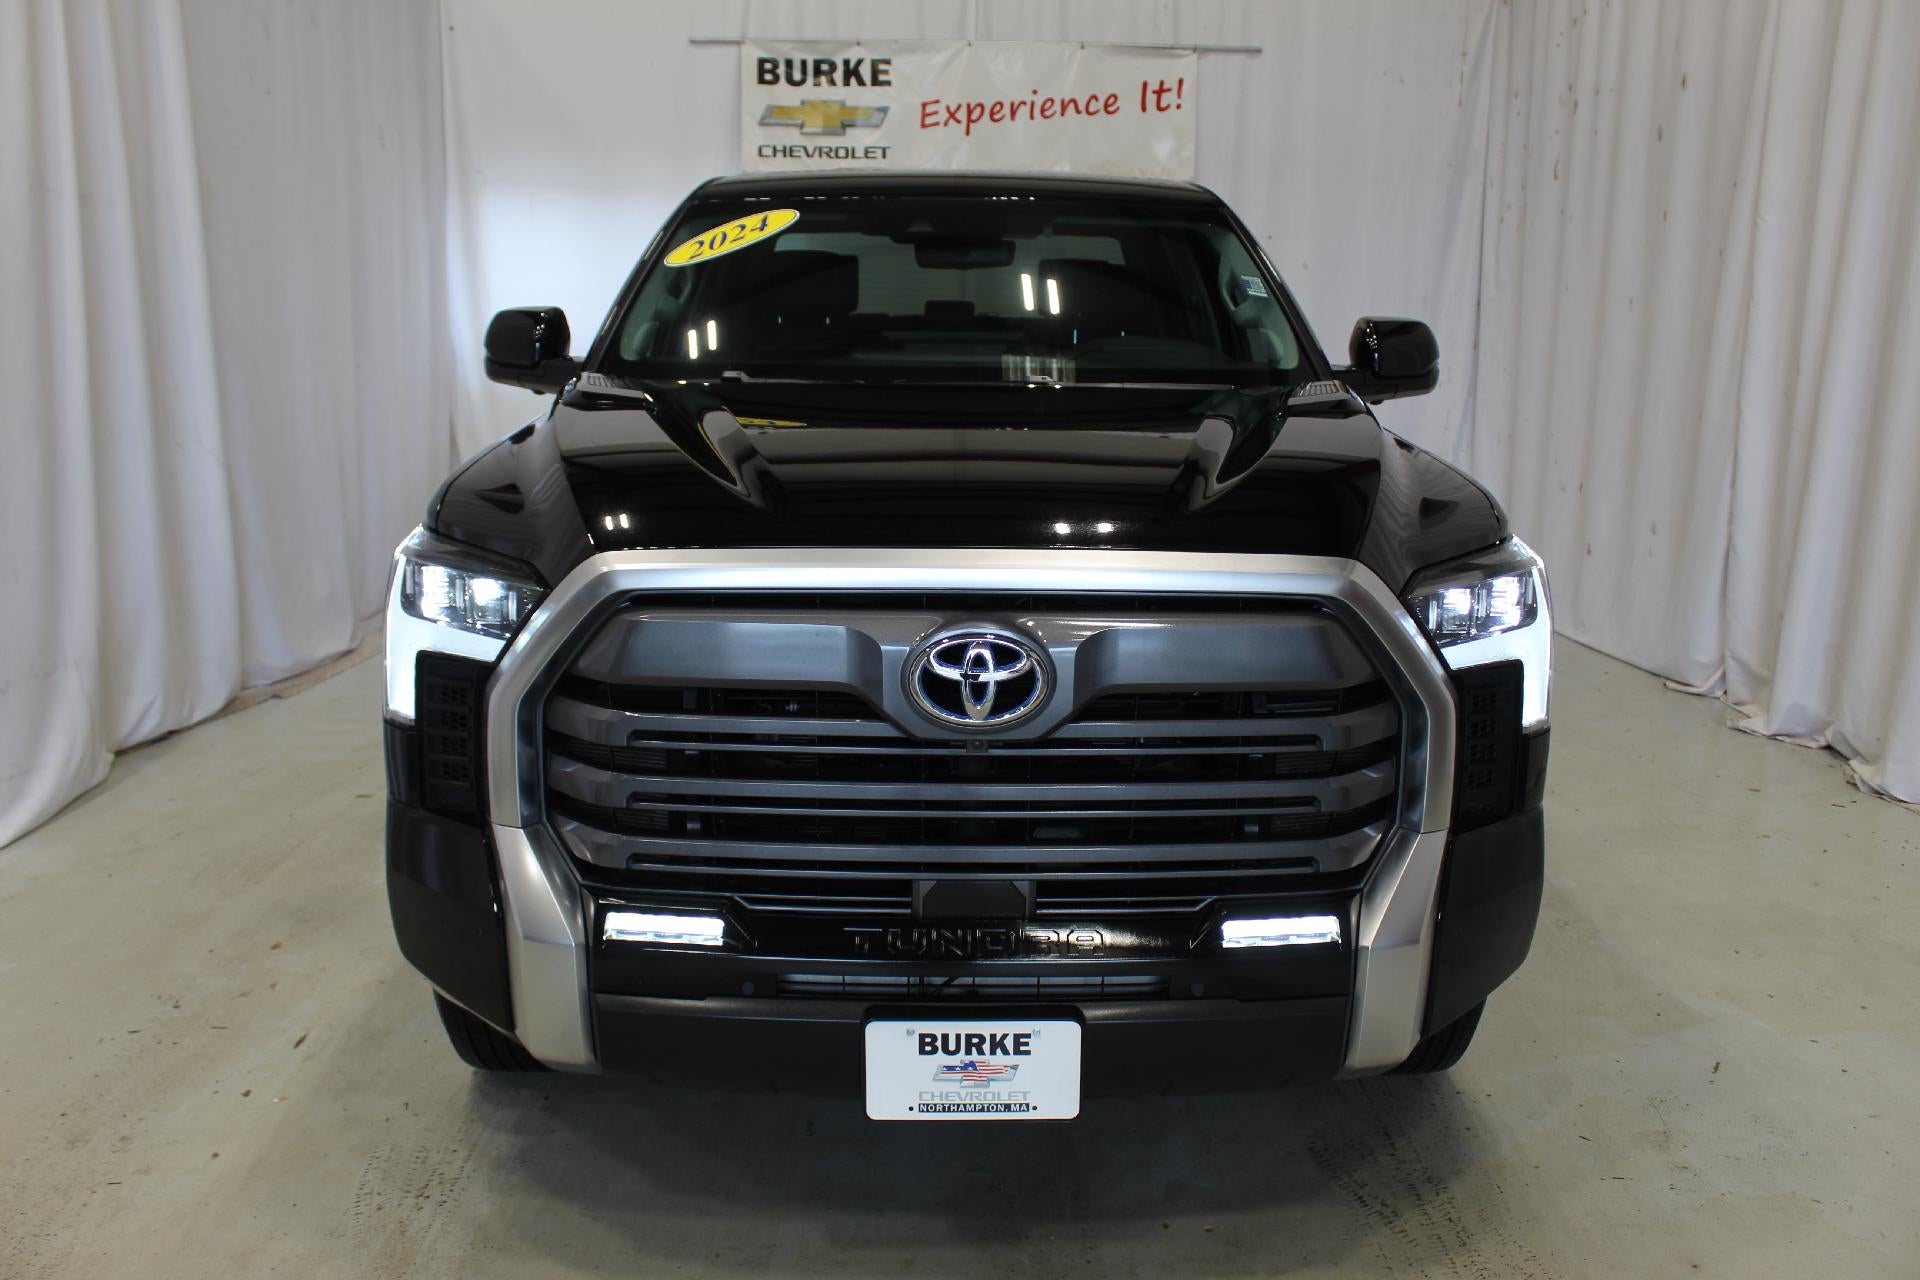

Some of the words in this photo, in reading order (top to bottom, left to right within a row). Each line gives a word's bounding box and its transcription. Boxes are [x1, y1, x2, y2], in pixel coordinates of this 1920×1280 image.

[757, 57, 892, 87] BURKE
[919, 88, 1121, 136] Experience
[1139, 77, 1185, 113] It!
[758, 144, 890, 160] CHEVROLET
[688, 214, 770, 260] 2024
[918, 1032, 1032, 1056] BURKE
[919, 1090, 1031, 1102] CHEVROLET
[919, 1103, 1009, 1113] NORTHAMPTON,
[1010, 1103, 1029, 1113] MA
